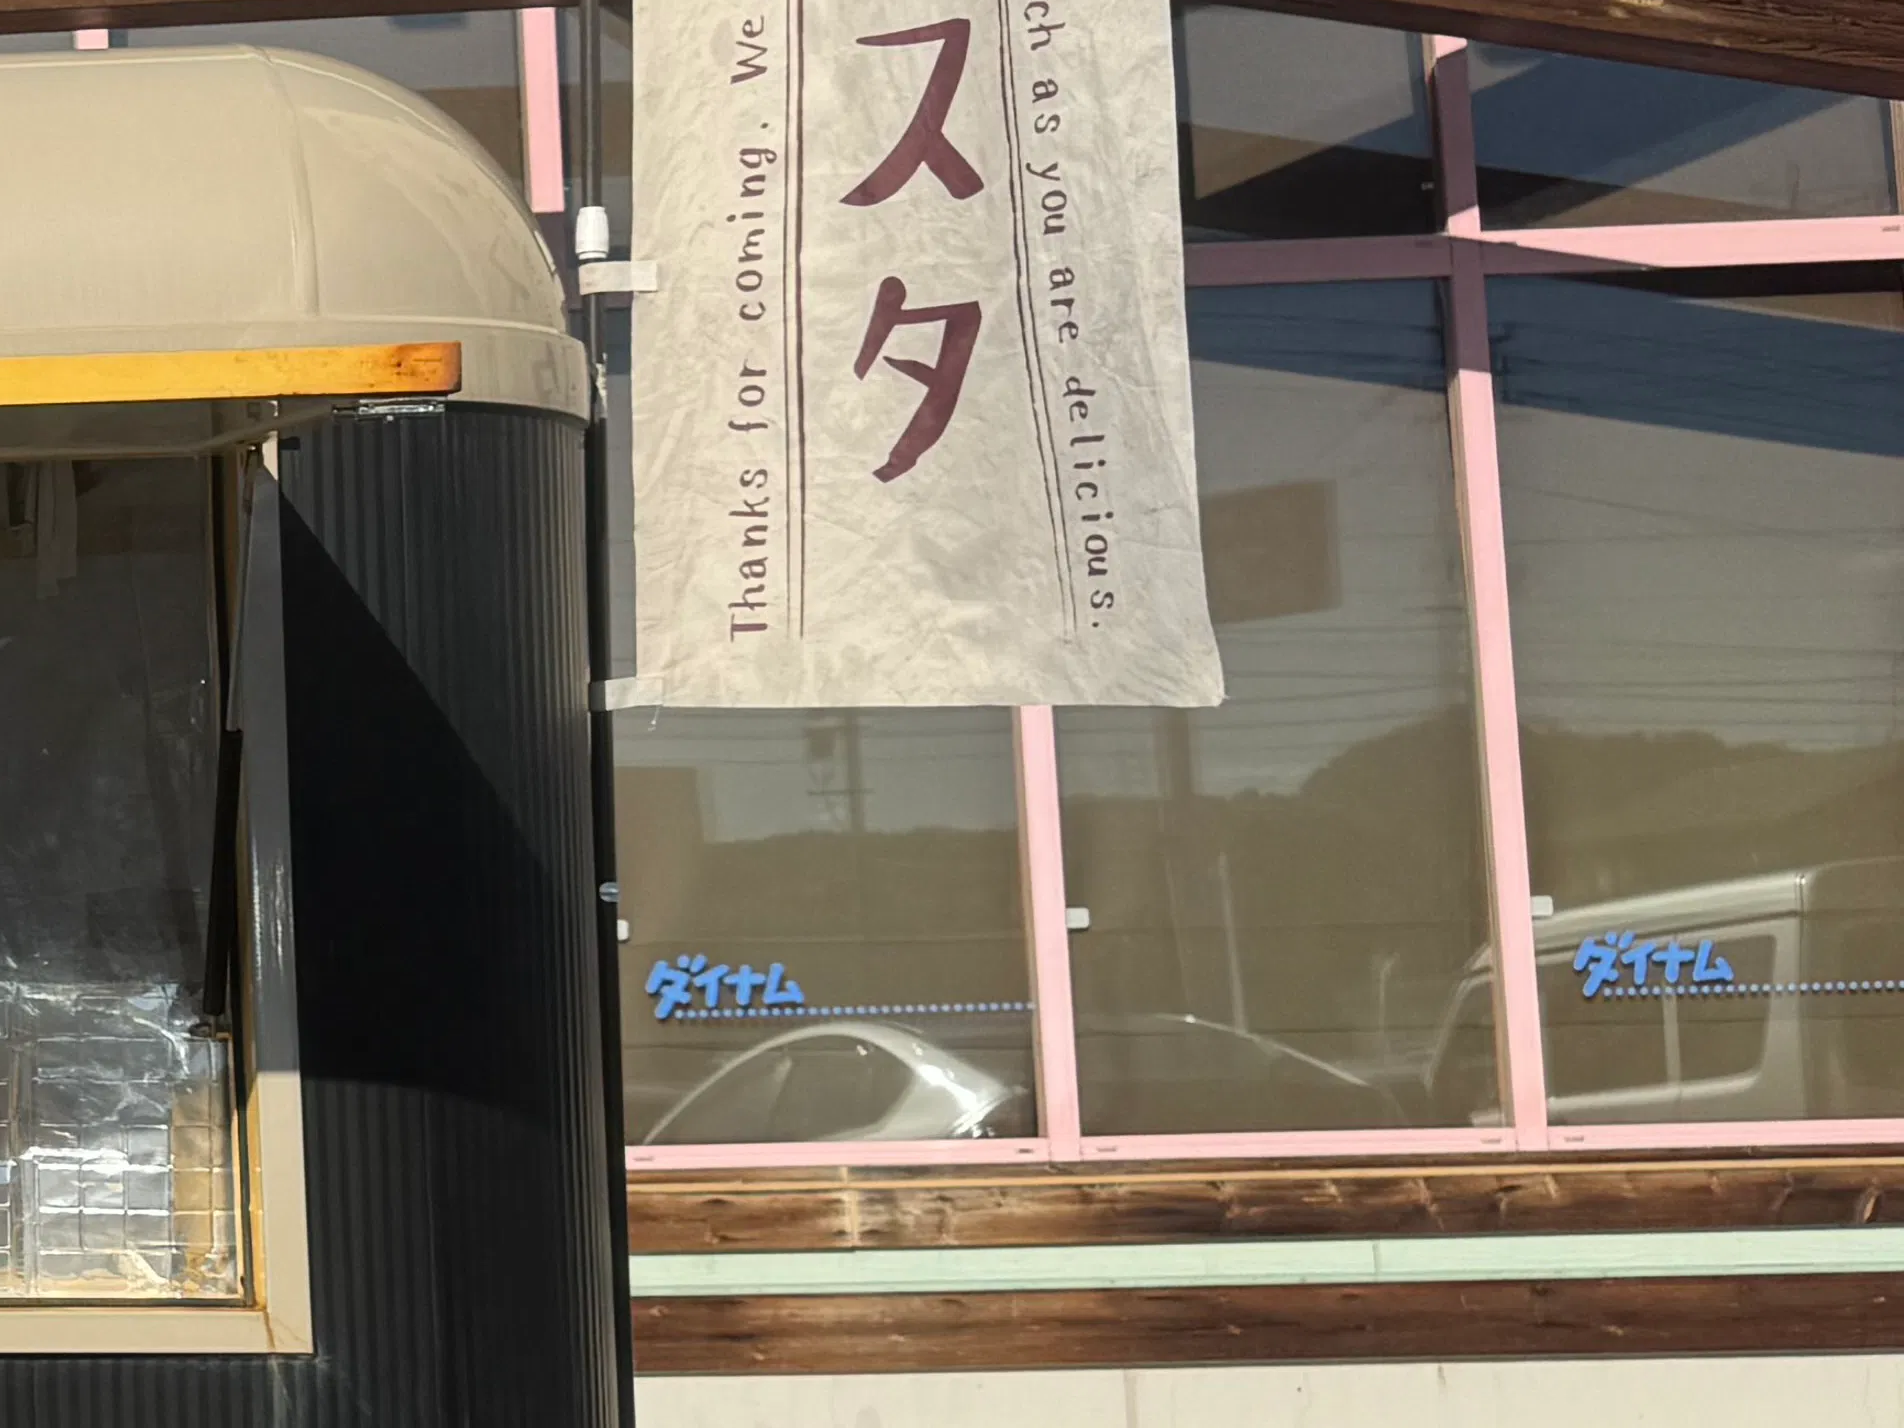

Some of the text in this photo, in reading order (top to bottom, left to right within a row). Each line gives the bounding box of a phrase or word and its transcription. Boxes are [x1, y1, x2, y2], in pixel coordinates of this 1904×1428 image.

[730, 16, 768, 84] We
[1032, 78, 1061, 134] as
[727, 123, 778, 321] coming.
[1024, 162, 1067, 236] you
[1049, 266, 1079, 343] are
[728, 358, 769, 432] for
[1062, 376, 1116, 628] delicious.
[729, 469, 770, 641] Thanks
[645, 953, 805, 1020] ダイナム
[1573, 931, 1735, 998] ダイナム
